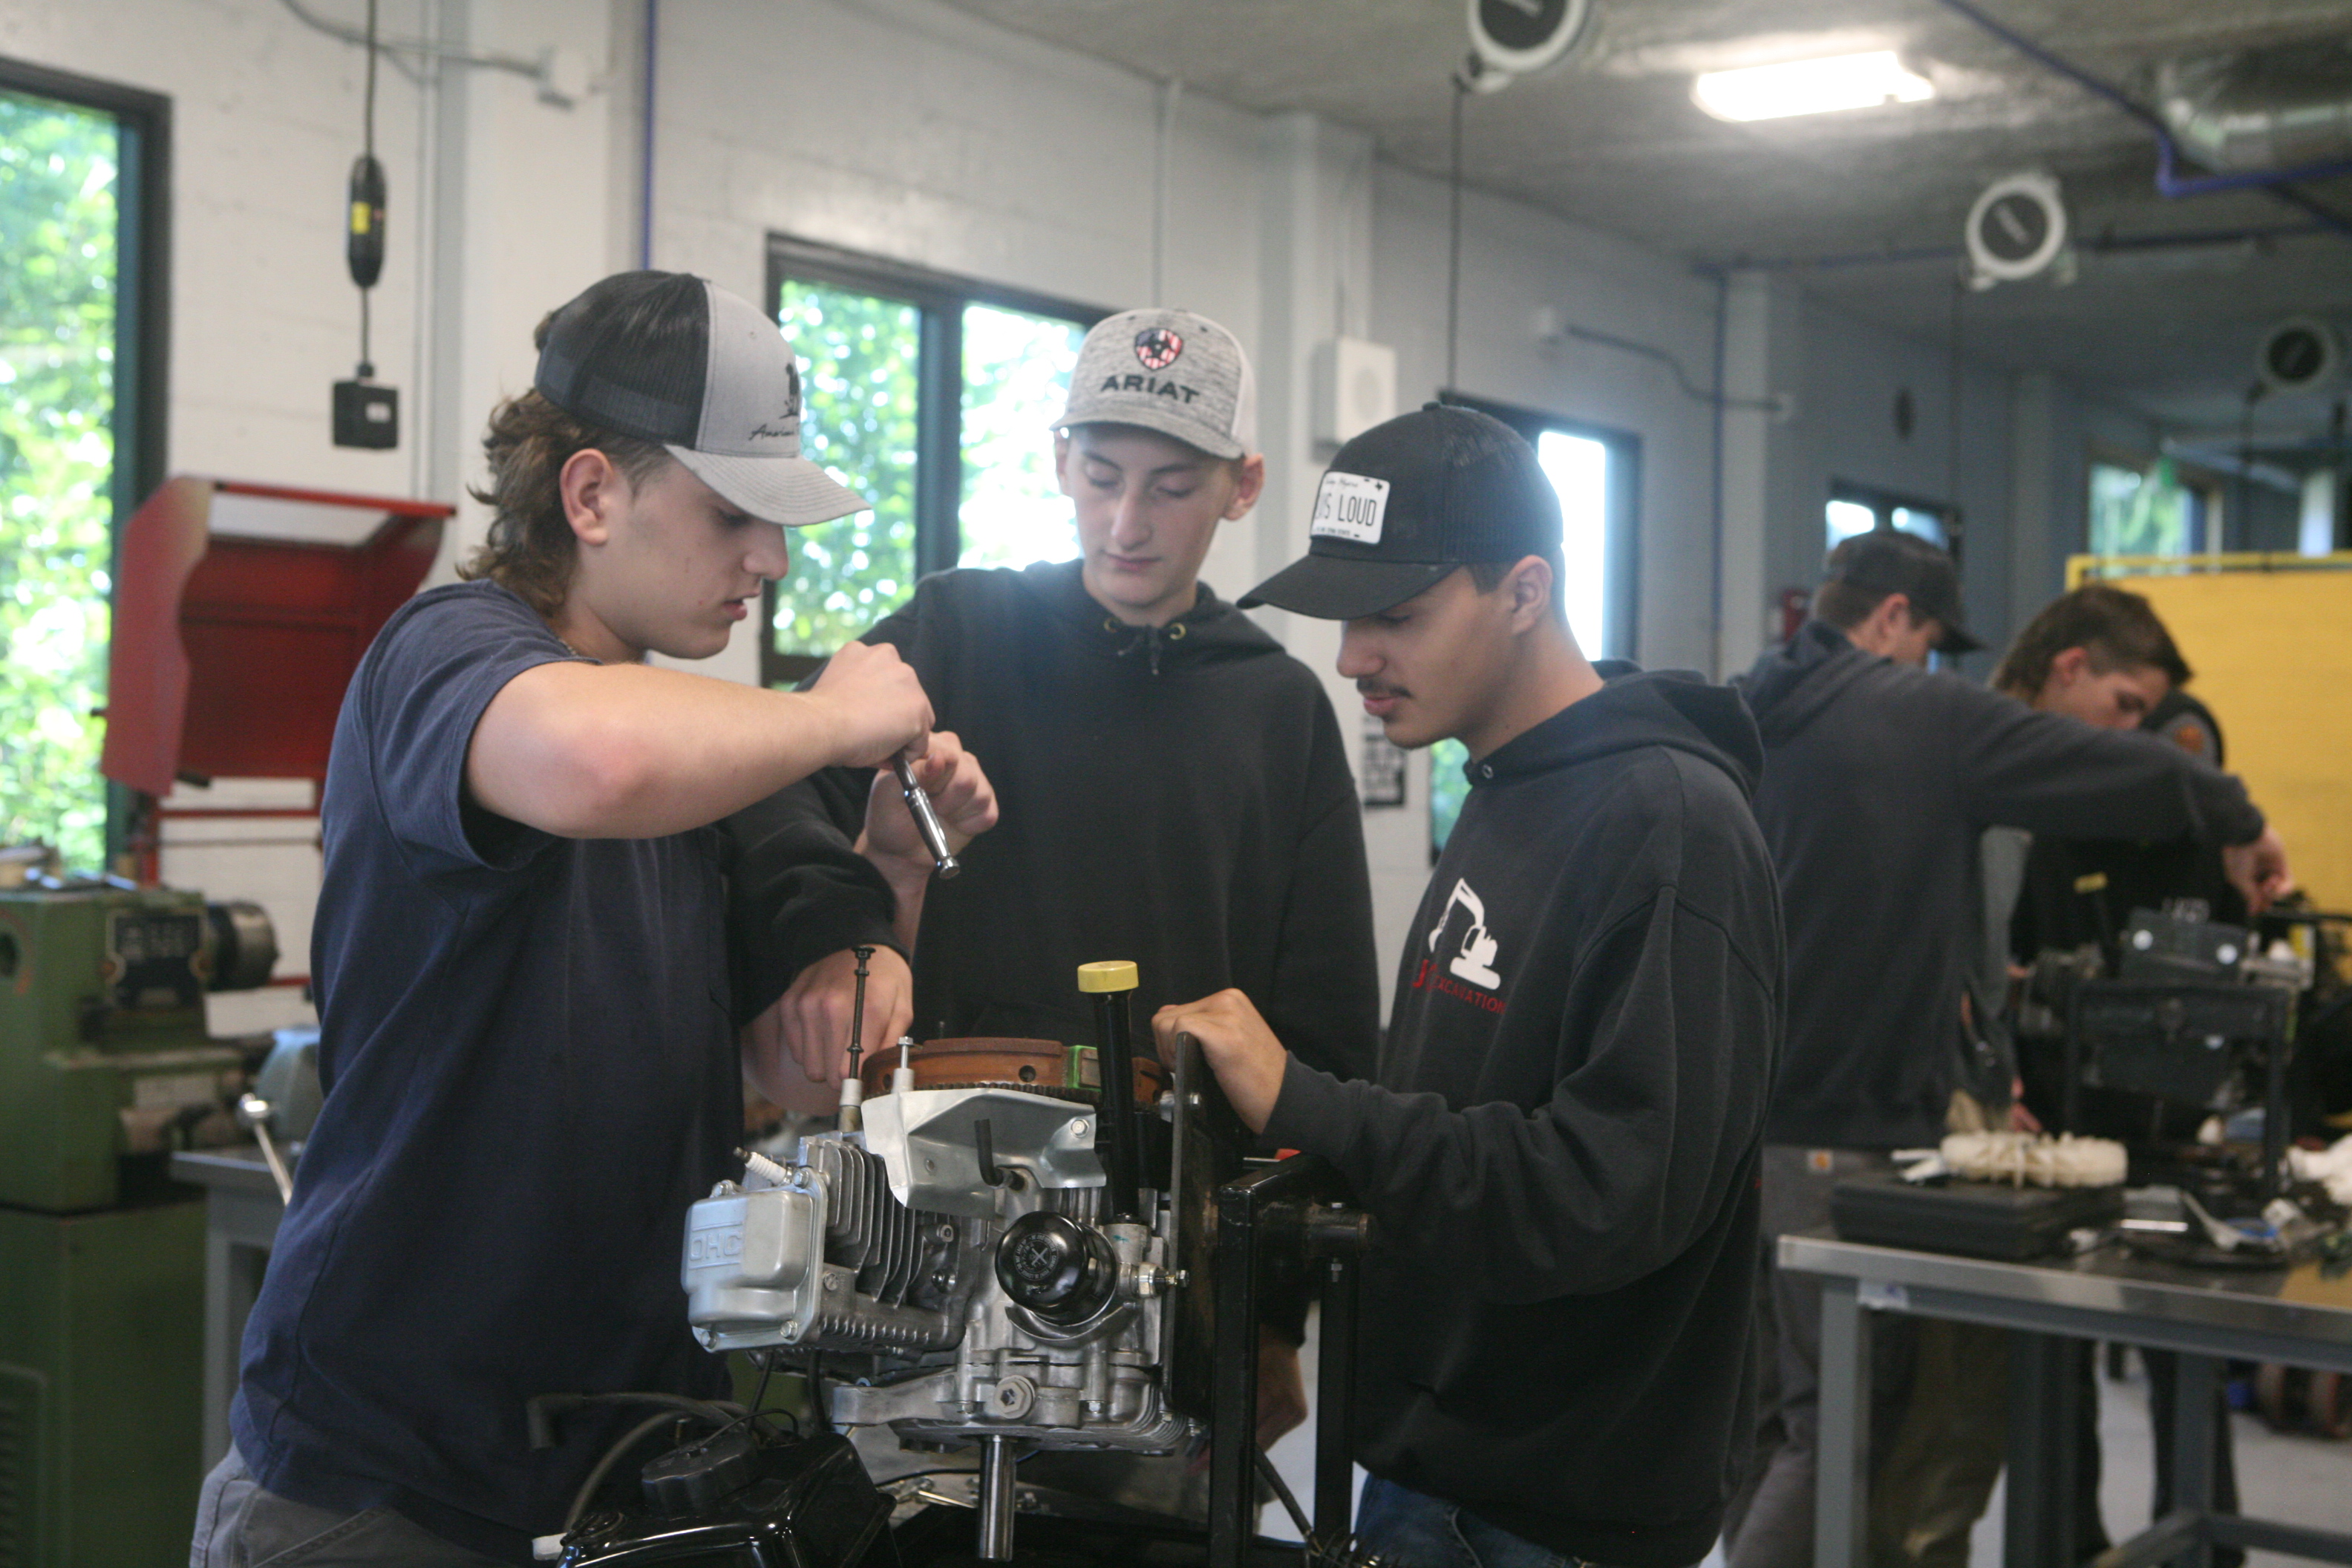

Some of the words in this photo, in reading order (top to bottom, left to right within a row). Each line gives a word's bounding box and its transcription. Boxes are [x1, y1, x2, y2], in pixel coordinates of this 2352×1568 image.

[1100, 373, 1200, 404] ARIAT
[1337, 494, 1377, 527] LOUD
[689, 1231, 742, 1261] OHC
